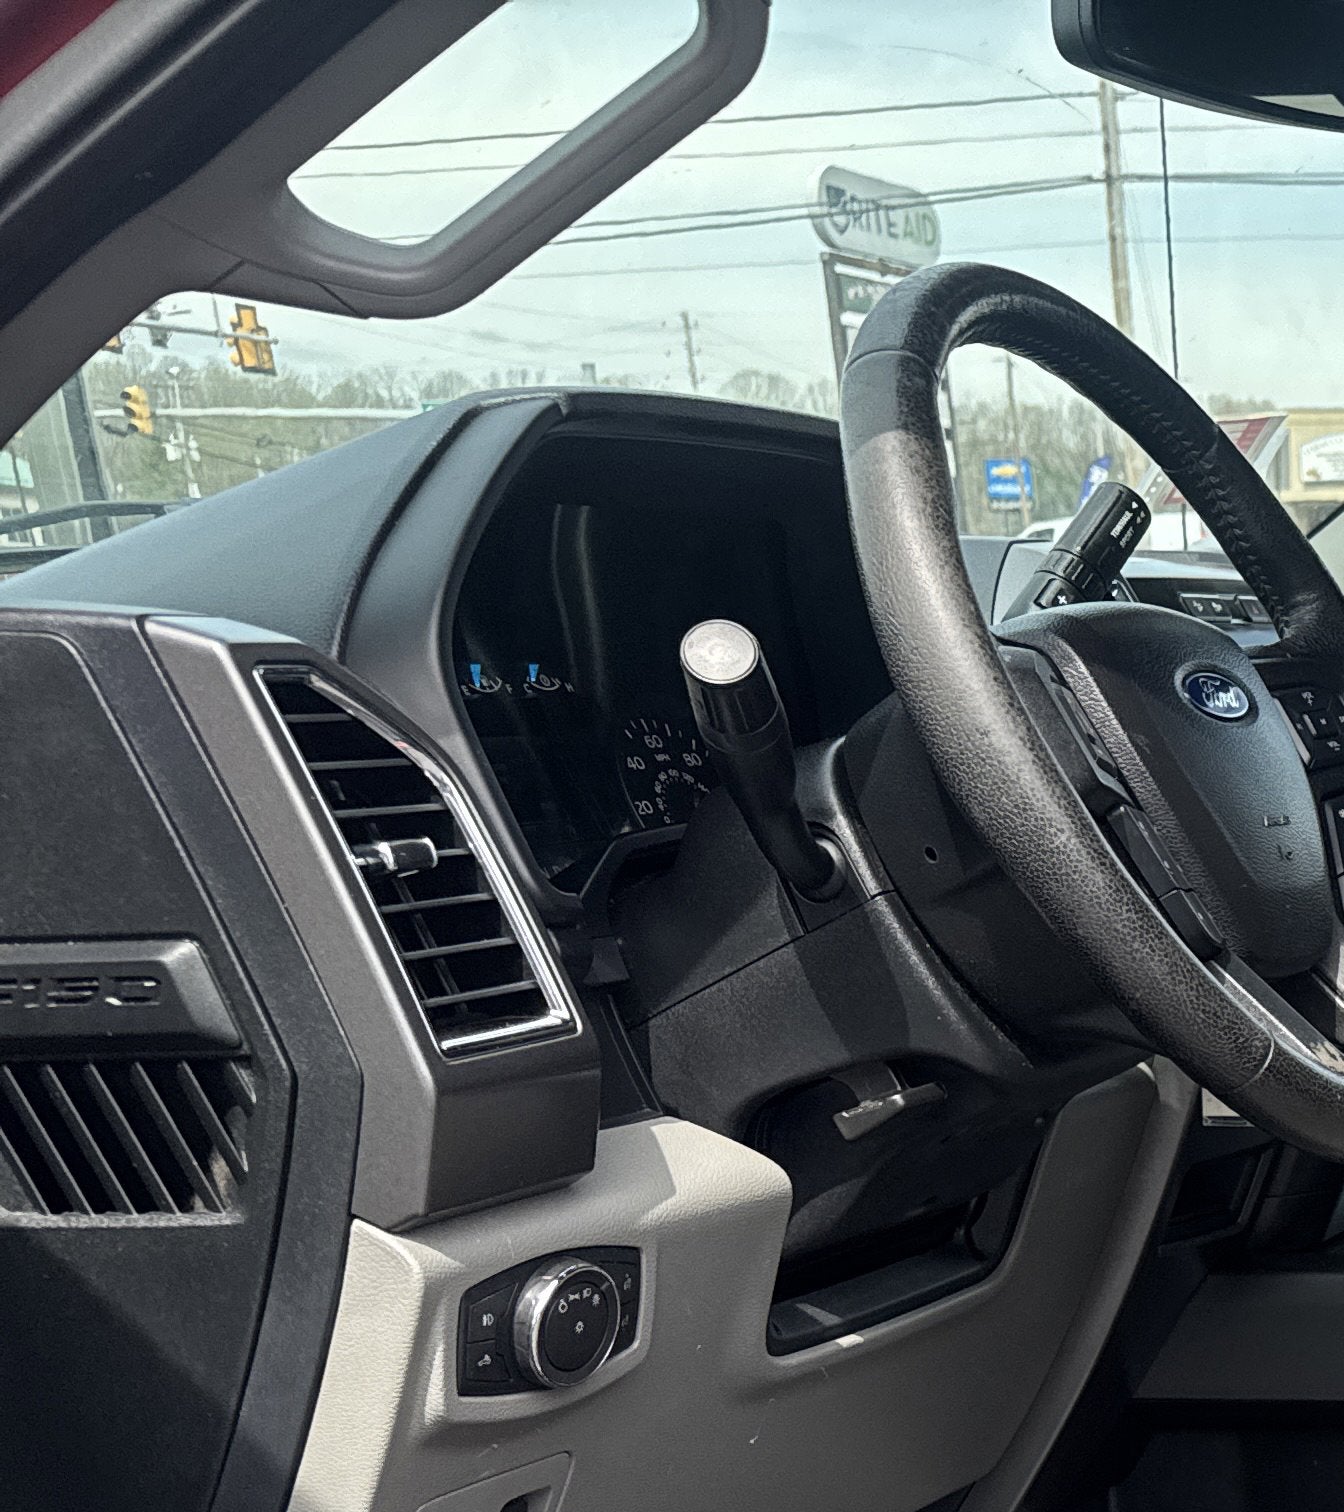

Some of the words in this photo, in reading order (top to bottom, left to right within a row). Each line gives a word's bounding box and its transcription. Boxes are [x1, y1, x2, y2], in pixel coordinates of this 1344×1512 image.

[851, 197, 899, 239] RITE
[904, 207, 937, 246] AID
[1199, 678, 1239, 708] Ford
[643, 734, 663, 749] 60
[626, 756, 646, 770] 40
[682, 752, 702, 767] 80
[634, 800, 654, 815] 20
